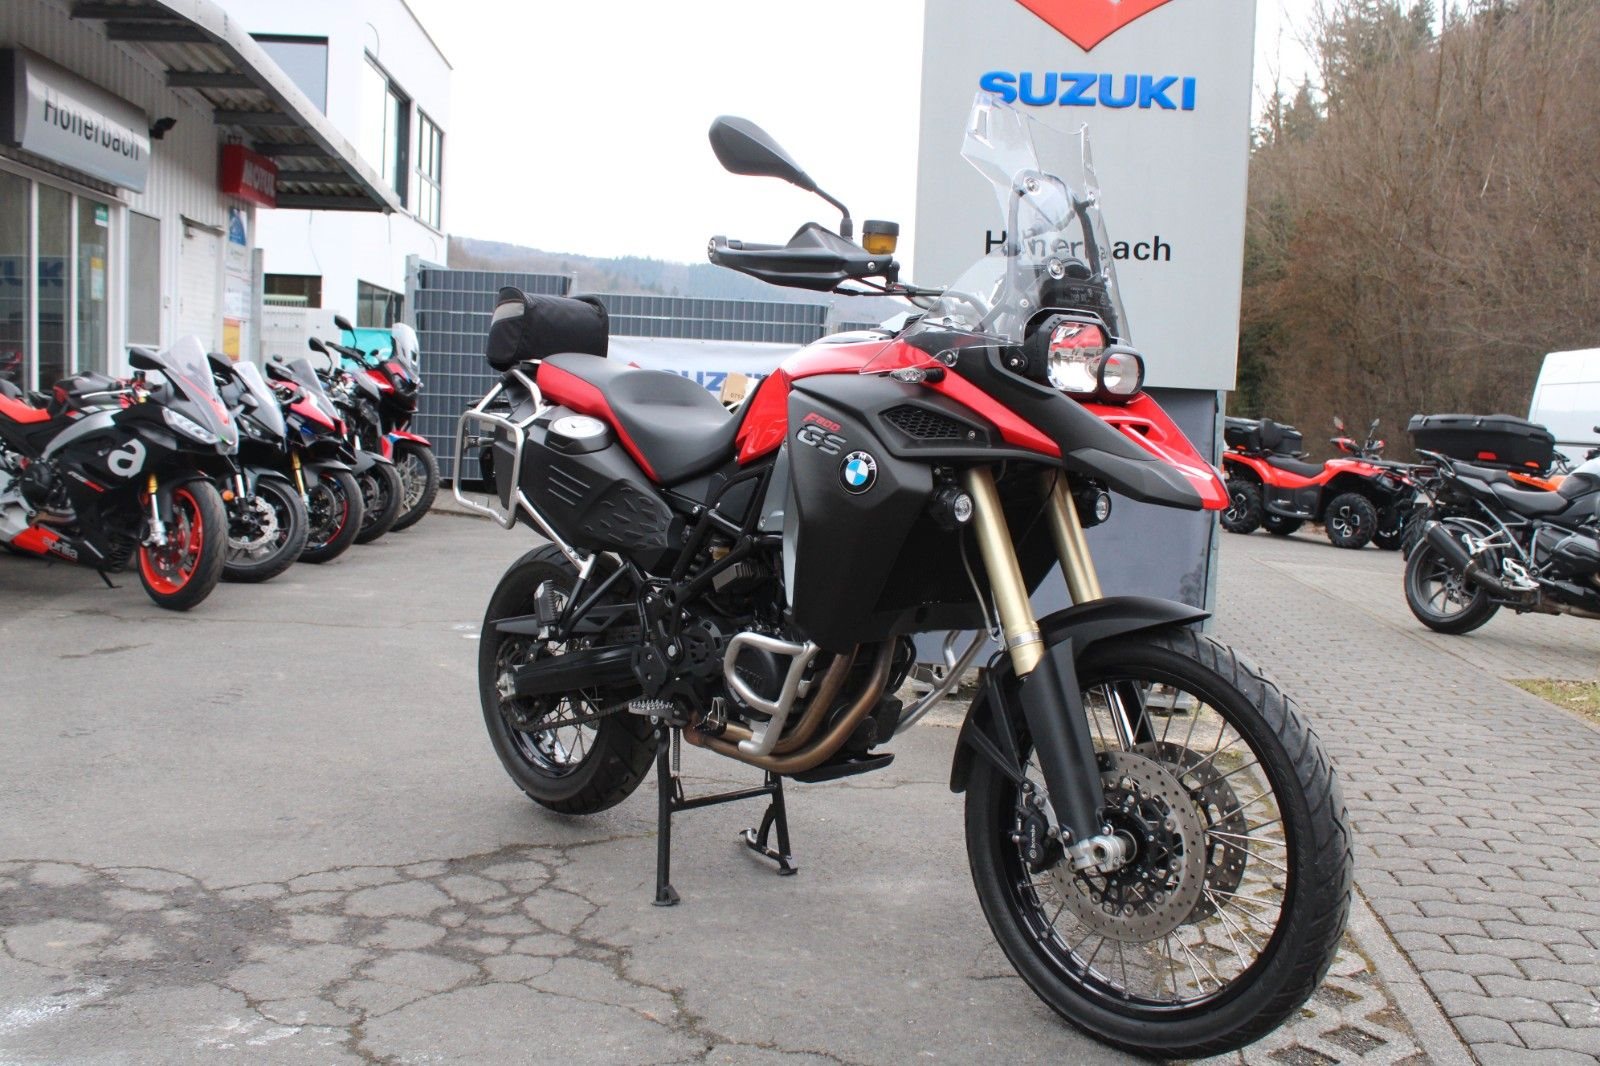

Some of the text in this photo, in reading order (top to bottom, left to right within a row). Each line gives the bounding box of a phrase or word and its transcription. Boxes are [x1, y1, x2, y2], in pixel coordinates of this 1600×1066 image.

[979, 71, 1196, 111] SUZUKI
[802, 411, 841, 432] F800
[796, 425, 847, 455] GS
[846, 451, 877, 471] BMW
